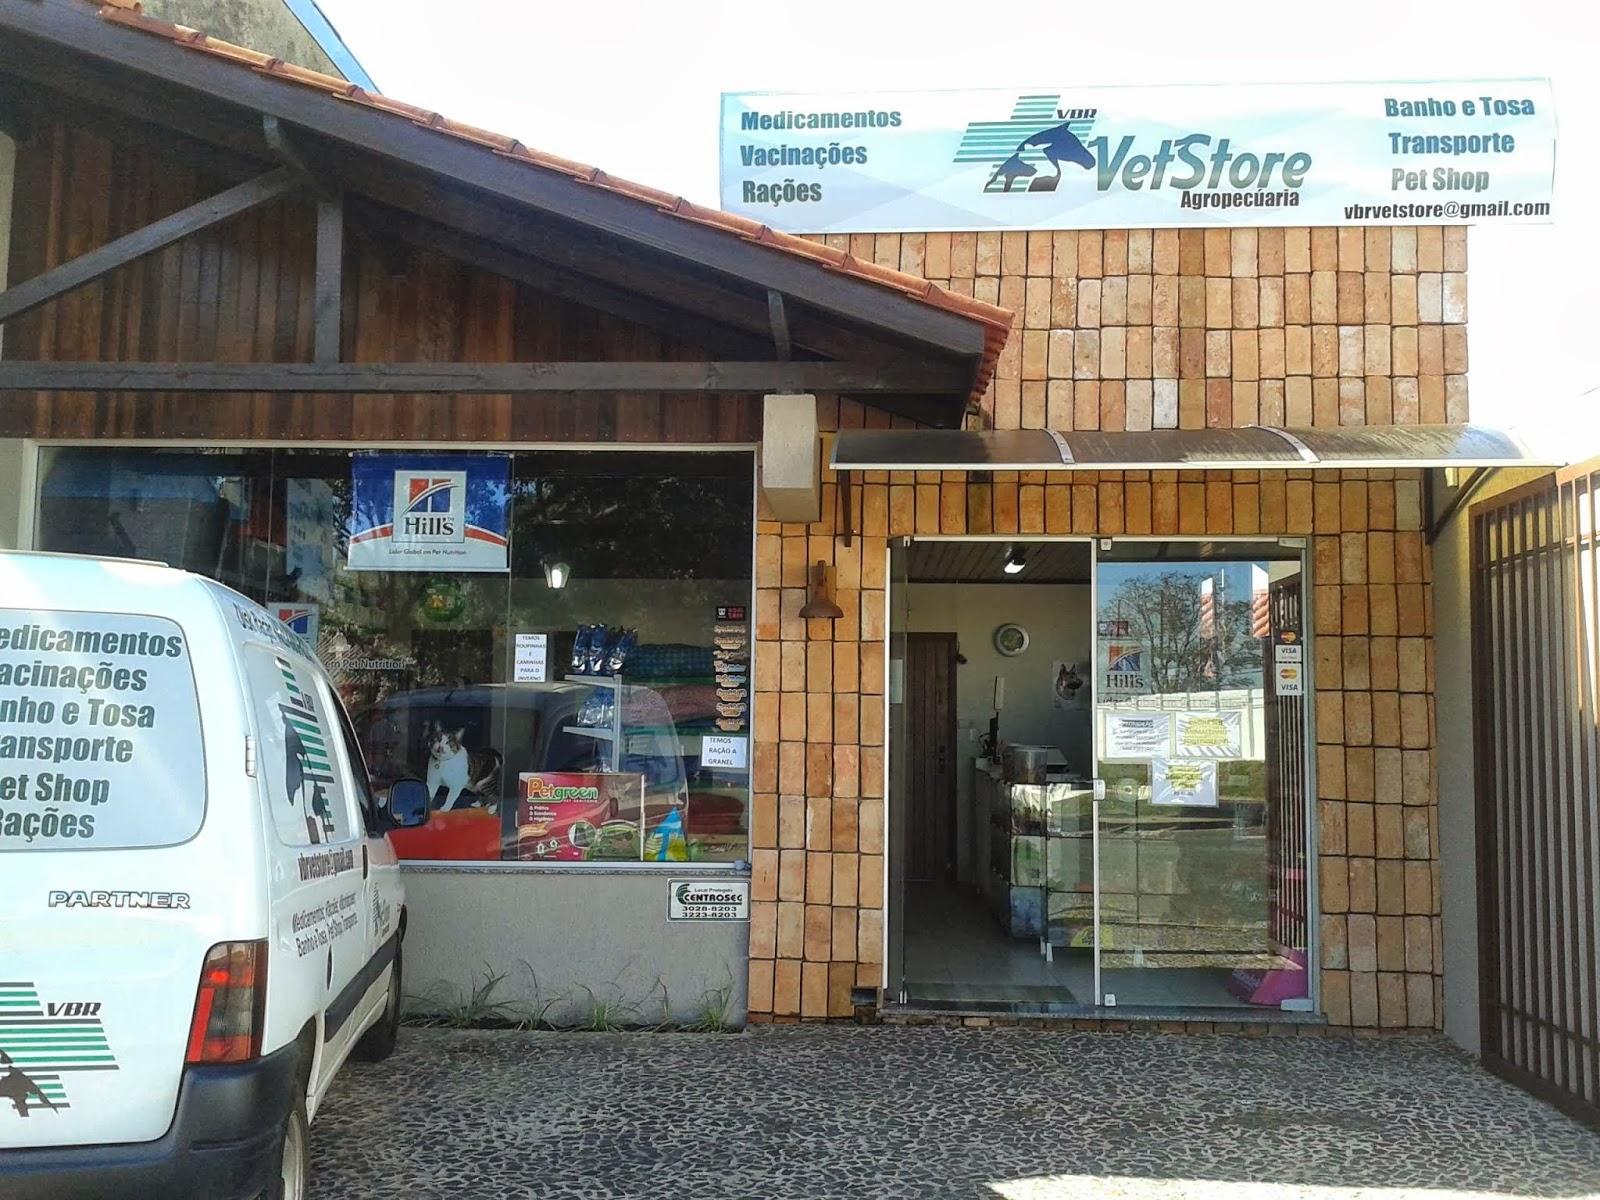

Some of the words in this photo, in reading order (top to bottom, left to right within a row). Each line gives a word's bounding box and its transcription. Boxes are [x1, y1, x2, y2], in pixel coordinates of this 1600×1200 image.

[1056, 108, 1097, 119] VBR
[1384, 97, 1456, 117] Banho
[1462, 101, 1475, 116] e
[1479, 97, 1535, 116] Tosa
[741, 109, 902, 131] Medicamentos
[1388, 132, 1515, 156] Transporte
[740, 143, 867, 170] Vacinações
[1087, 133, 1312, 191] VetStore
[1391, 168, 1428, 191] Pet
[1432, 167, 1490, 193] Shop
[742, 178, 822, 207] Rações
[1180, 188, 1299, 209] Agropecúaria
[1344, 200, 1551, 221] vbrvetstore@gmail.com
[405, 517, 454, 535] Hill's
[62, 702, 79, 725] e
[88, 698, 155, 728] Tosa
[0, 735, 133, 763] ansporte
[35, 772, 110, 805] Shop
[528, 778, 598, 801] Petgreen
[0, 807, 95, 842] ações
[48, 890, 190, 909] PARTNER
[47, 1002, 101, 1017] VBR
